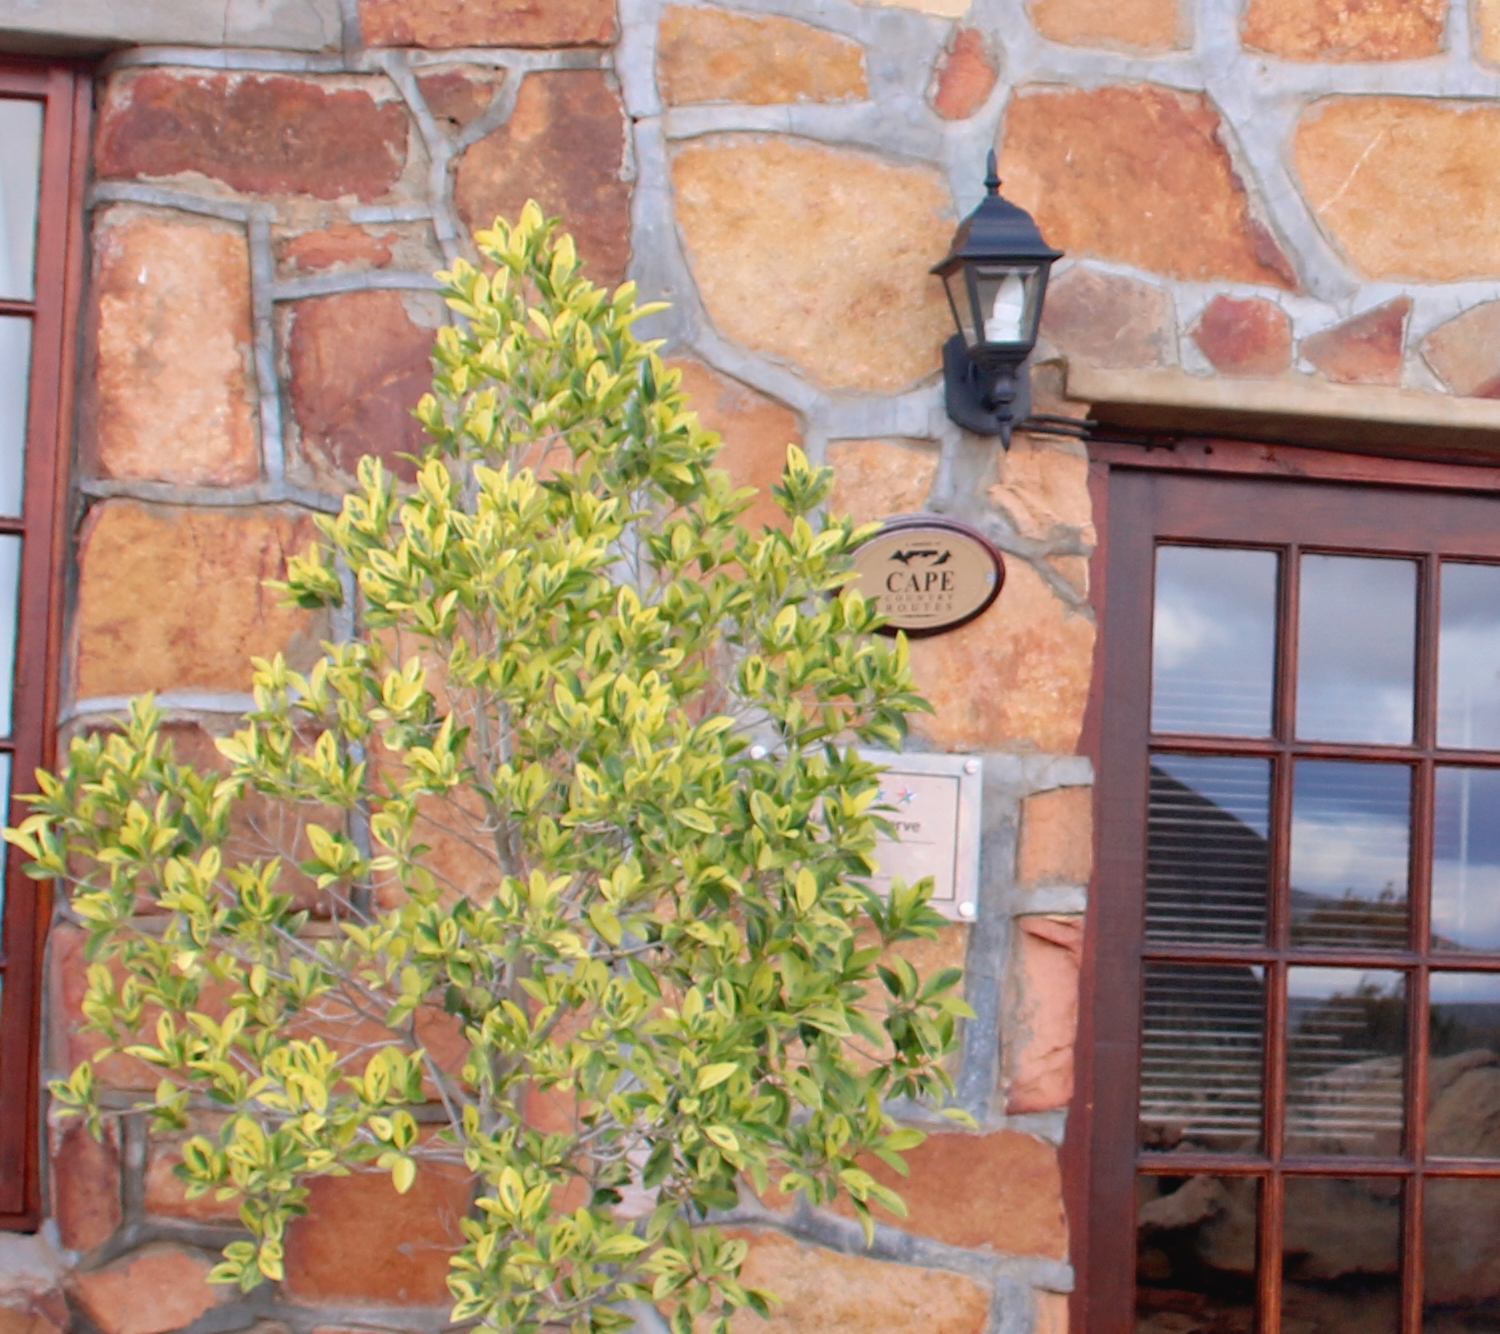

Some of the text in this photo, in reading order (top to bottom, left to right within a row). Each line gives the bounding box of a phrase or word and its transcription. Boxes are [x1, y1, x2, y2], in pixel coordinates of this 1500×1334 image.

[885, 570, 955, 593] CAPE
[884, 593, 953, 603] COUNTRY
[885, 603, 953, 612] ROUTES
